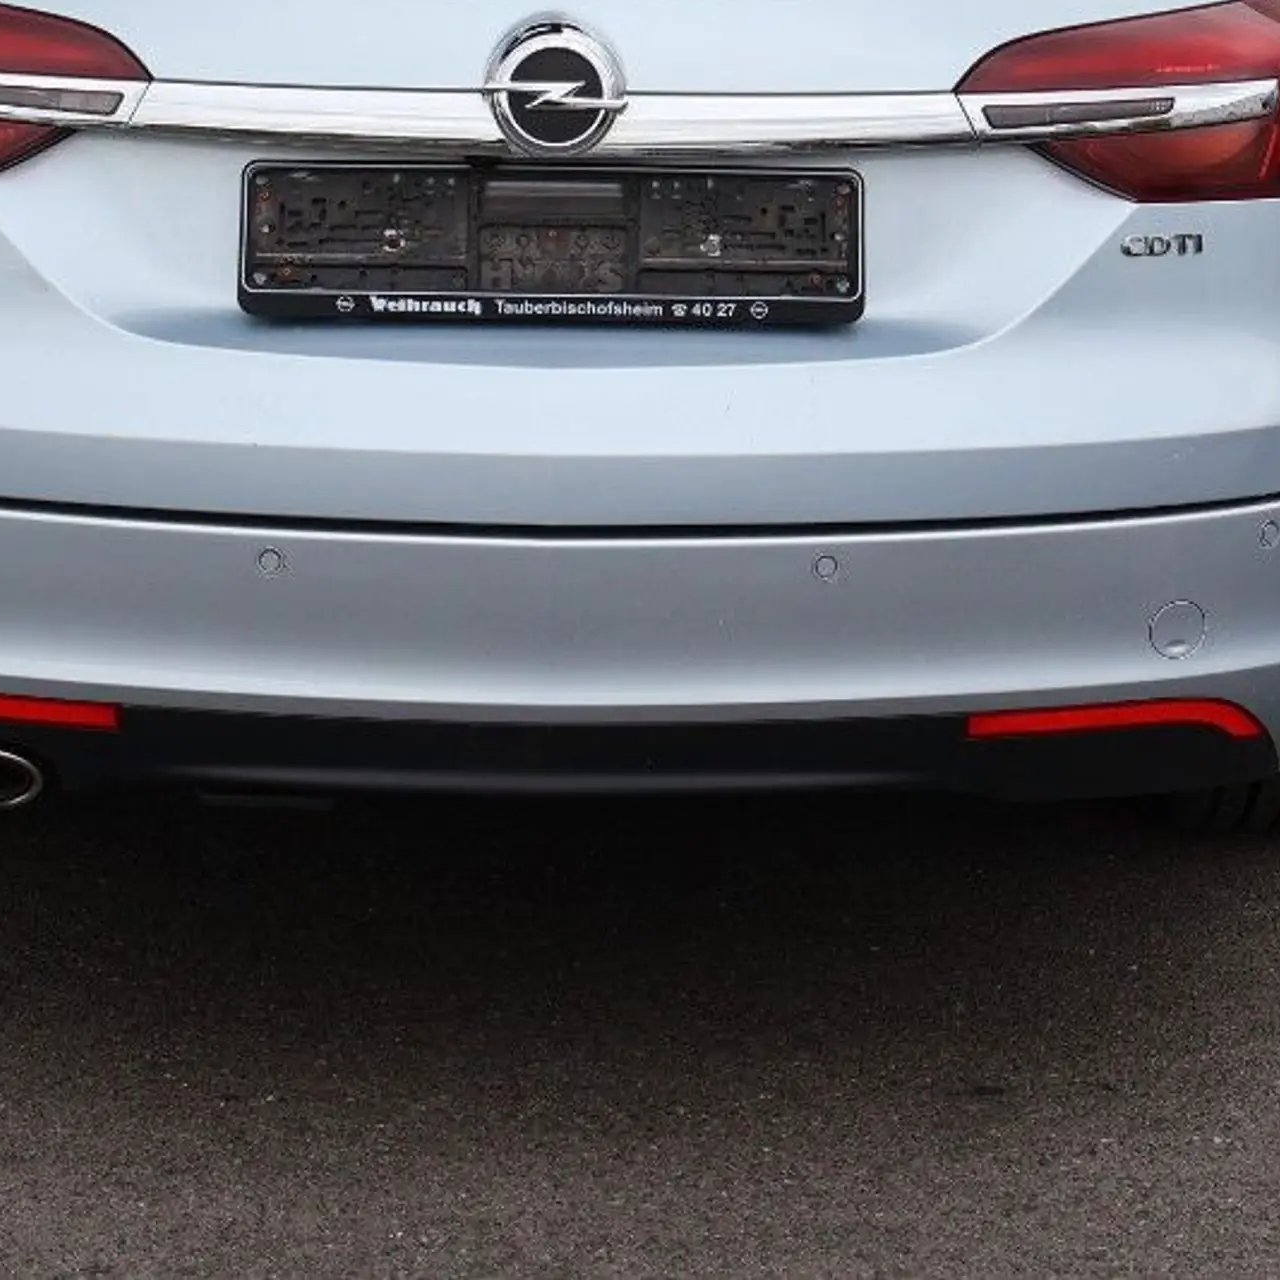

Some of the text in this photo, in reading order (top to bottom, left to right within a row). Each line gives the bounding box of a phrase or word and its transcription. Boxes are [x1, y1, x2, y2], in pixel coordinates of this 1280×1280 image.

[1120, 233, 1203, 257] CDTI
[370, 296, 736, 317] Weihrauch Tauberbischofsheim 40 27
